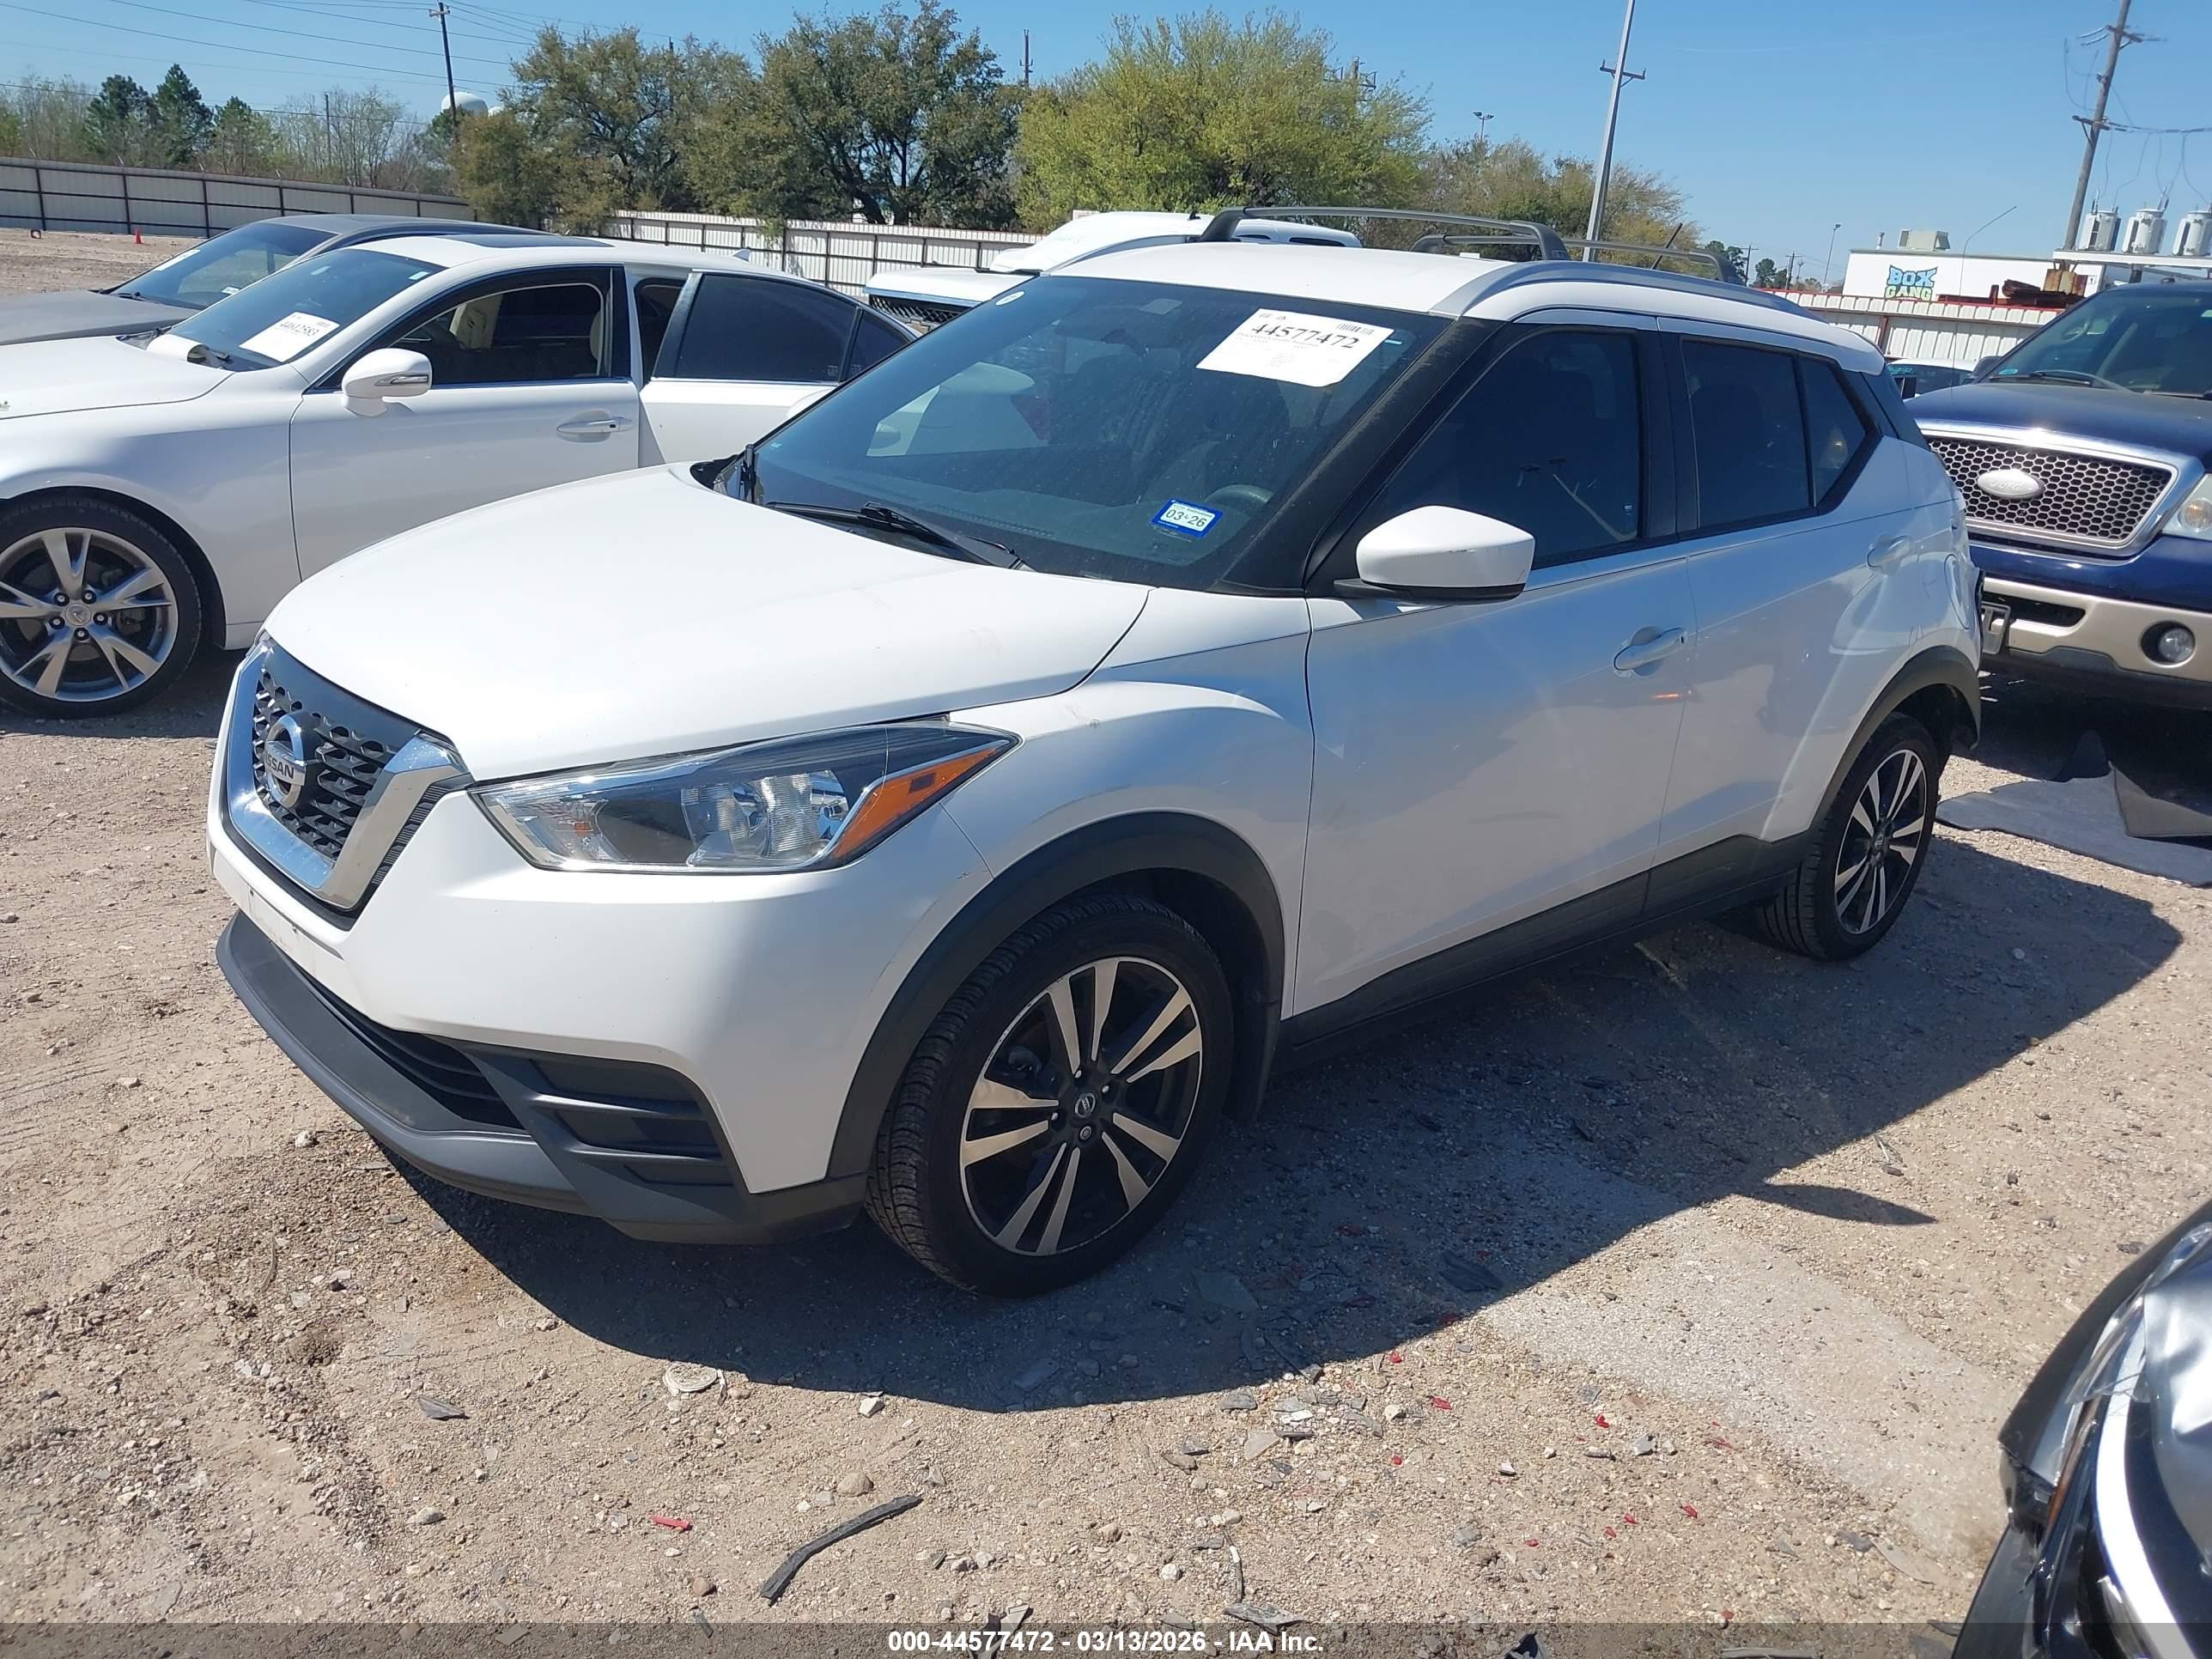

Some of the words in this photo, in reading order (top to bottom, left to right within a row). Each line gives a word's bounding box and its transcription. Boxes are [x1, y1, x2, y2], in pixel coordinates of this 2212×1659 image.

[1887, 264, 1937, 288] BOX
[1884, 284, 1933, 301] GANG
[1251, 323, 1360, 349] 44577472
[1165, 508, 1185, 520] 03
[1187, 515, 1207, 527] 26
